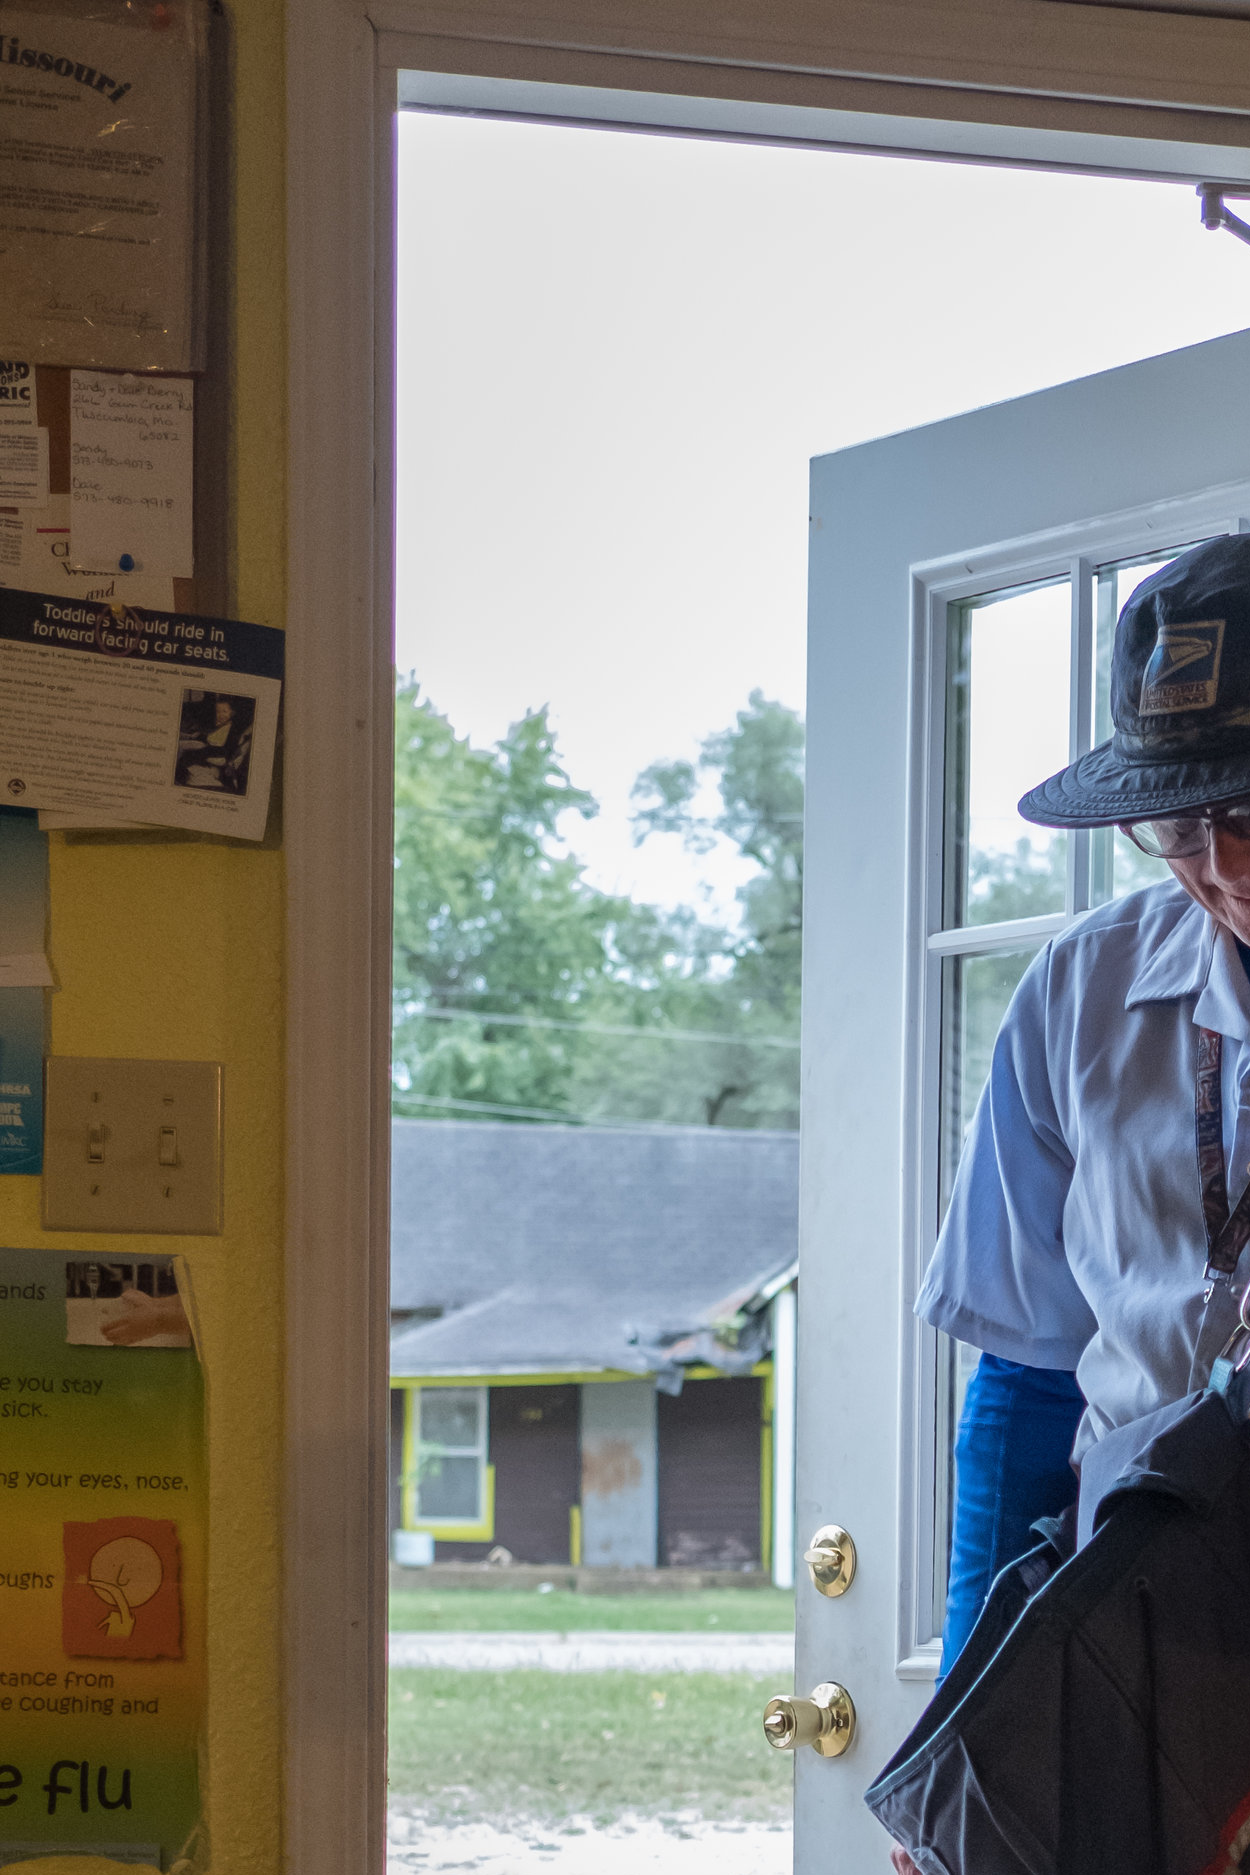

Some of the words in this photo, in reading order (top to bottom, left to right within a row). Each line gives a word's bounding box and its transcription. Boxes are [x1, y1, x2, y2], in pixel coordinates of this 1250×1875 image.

[33, 620, 94, 643] forward
[101, 631, 148, 654] facing
[154, 638, 178, 655] car
[185, 644, 230, 663] seats.
[174, 622, 204, 641] ride
[210, 626, 225, 643] in
[18, 1378, 54, 1393] you
[62, 1379, 103, 1396] stay
[2, 1401, 48, 1418] sick.
[26, 1473, 72, 1488] your
[79, 1473, 128, 1490] eyes,
[137, 1475, 188, 1492] nose,
[64, 1672, 114, 1689] from
[19, 1696, 114, 1716] coughing
[121, 1697, 159, 1714] and
[43, 1760, 133, 1815] flu
